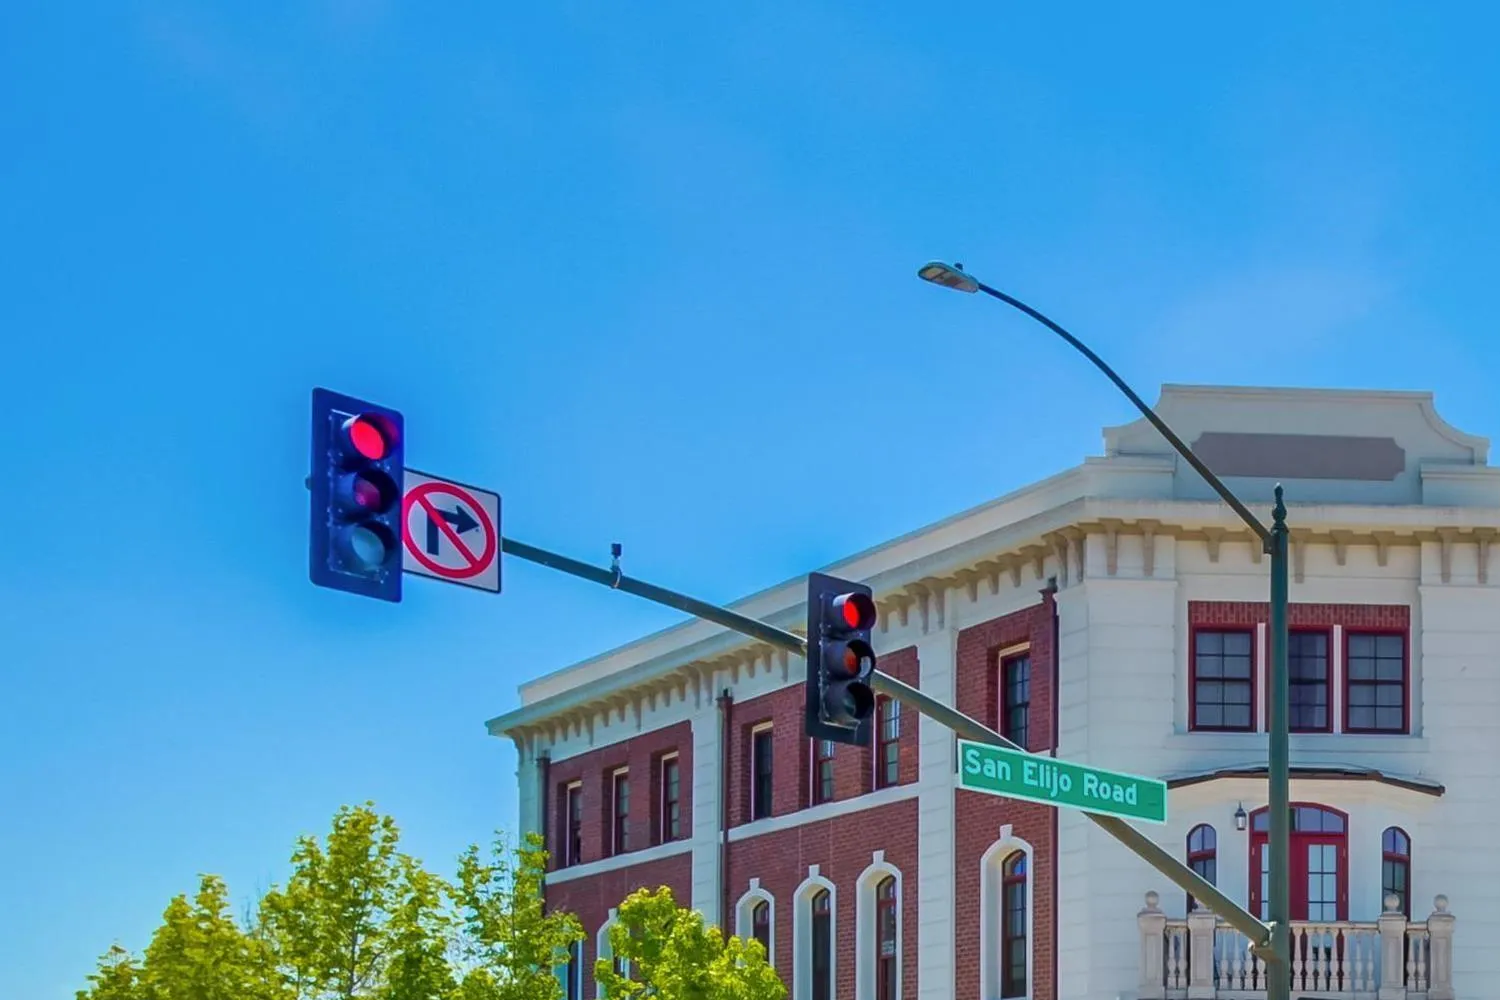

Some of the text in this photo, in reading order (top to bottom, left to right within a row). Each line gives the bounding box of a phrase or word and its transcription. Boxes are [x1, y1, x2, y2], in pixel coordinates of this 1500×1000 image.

[964, 749, 1137, 805] San Elijo Road
